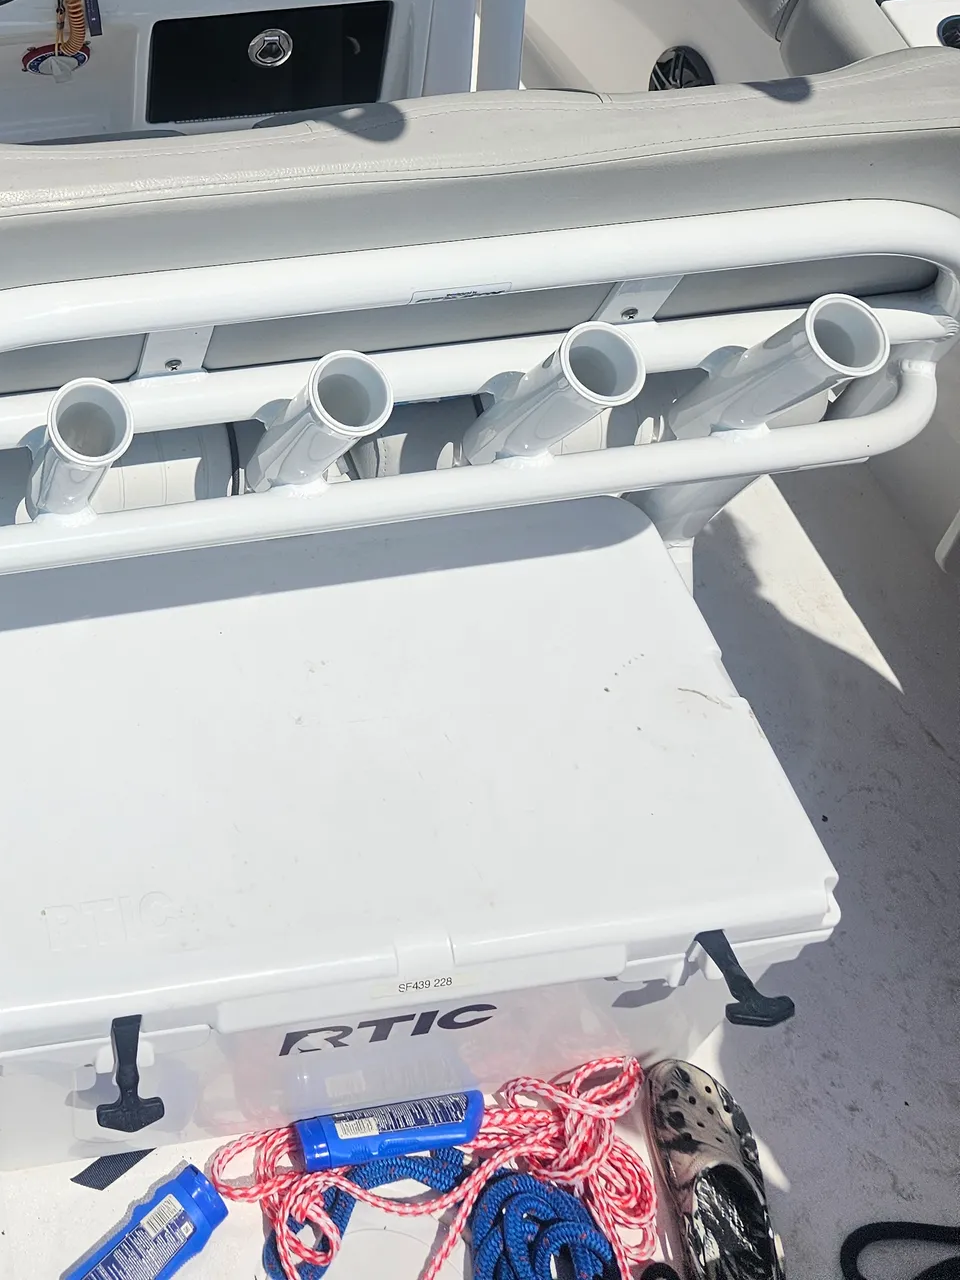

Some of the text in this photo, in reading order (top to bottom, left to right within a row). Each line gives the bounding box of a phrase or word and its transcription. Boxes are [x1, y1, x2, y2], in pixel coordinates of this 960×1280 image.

[398, 977, 453, 993] SF439 228
[278, 1003, 498, 1057] RTIC
